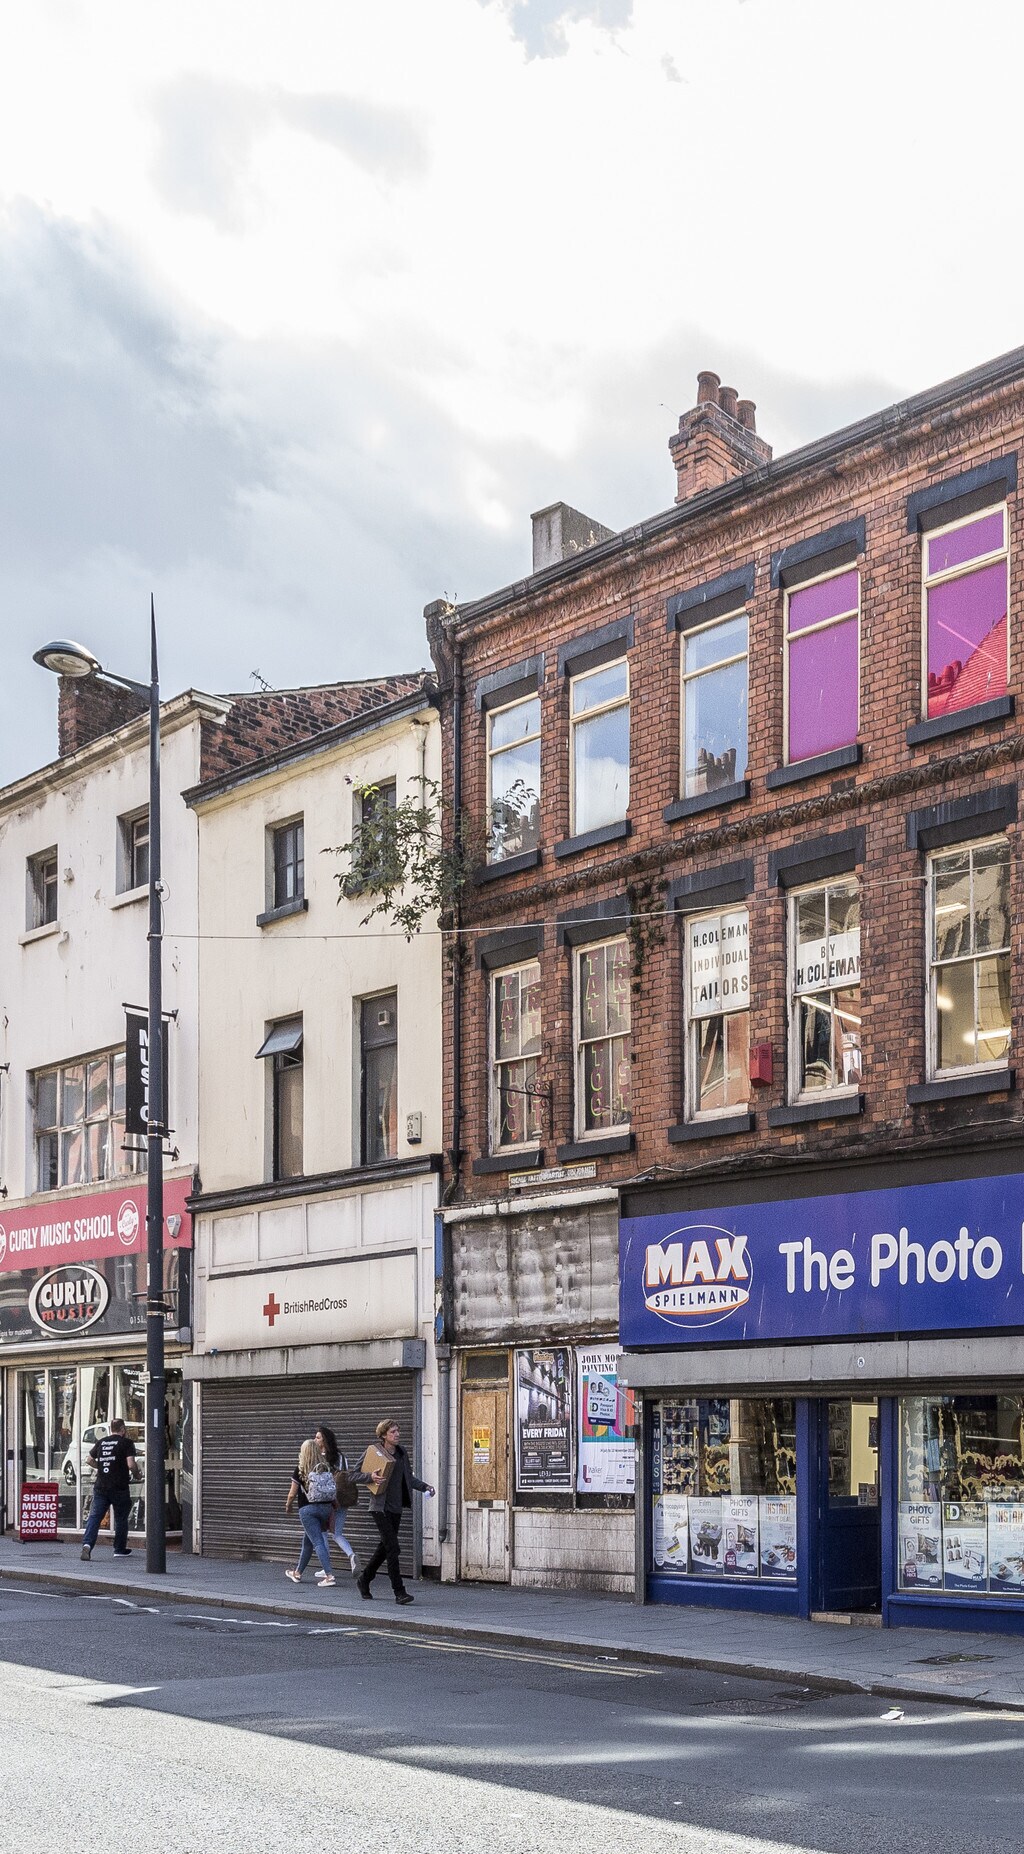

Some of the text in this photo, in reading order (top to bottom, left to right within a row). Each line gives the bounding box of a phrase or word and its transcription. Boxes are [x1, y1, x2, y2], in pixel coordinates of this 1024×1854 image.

[693, 948, 748, 972] INDIVIDUAL
[693, 974, 748, 1002] TAILORS
[9, 1214, 114, 1252] CURLY MUSIC SCHOOL
[646, 1235, 749, 1288] MAX
[779, 1237, 856, 1293] The
[870, 1225, 1004, 1289] Photo
[40, 1278, 96, 1308] CURLY
[654, 1289, 740, 1308] SPIELMANN
[41, 1304, 95, 1321] music
[582, 1355, 601, 1364] JOHN
[522, 1427, 567, 1439] EVERY FRIDAY
[23, 1494, 57, 1502] SHEET
[730, 1499, 752, 1507] PHOTO
[22, 1502, 57, 1510] MUSIC
[731, 1508, 749, 1516] GIFTS
[908, 1506, 934, 1515] PHOTO
[22, 1511, 57, 1519] & SONG
[946, 1505, 960, 1520] iD
[21, 1520, 56, 1528] BOOKS
[910, 1516, 930, 1524] GIFTS
